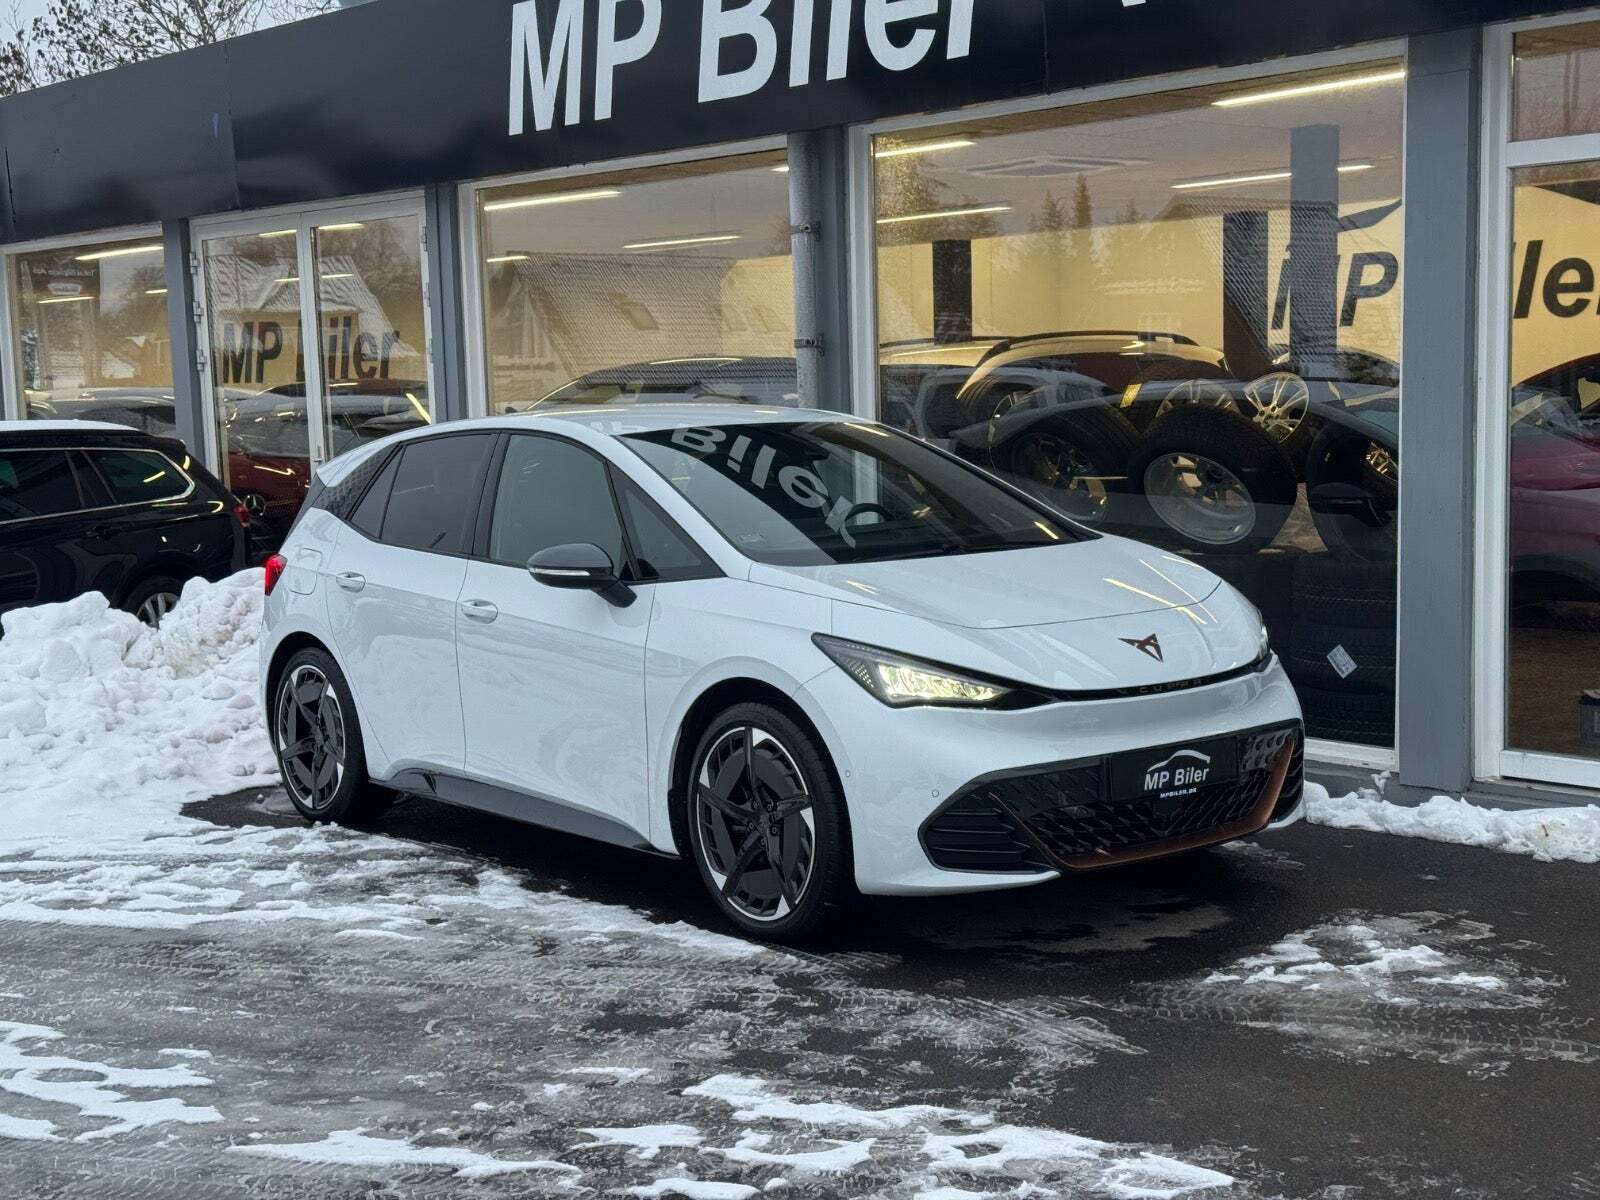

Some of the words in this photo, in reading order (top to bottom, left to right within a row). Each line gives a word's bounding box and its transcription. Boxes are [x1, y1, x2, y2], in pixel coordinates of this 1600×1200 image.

[508, 0, 662, 136] MP
[223, 321, 283, 384] MP
[1144, 771, 1170, 791] MP
[1174, 766, 1210, 786] Biler
